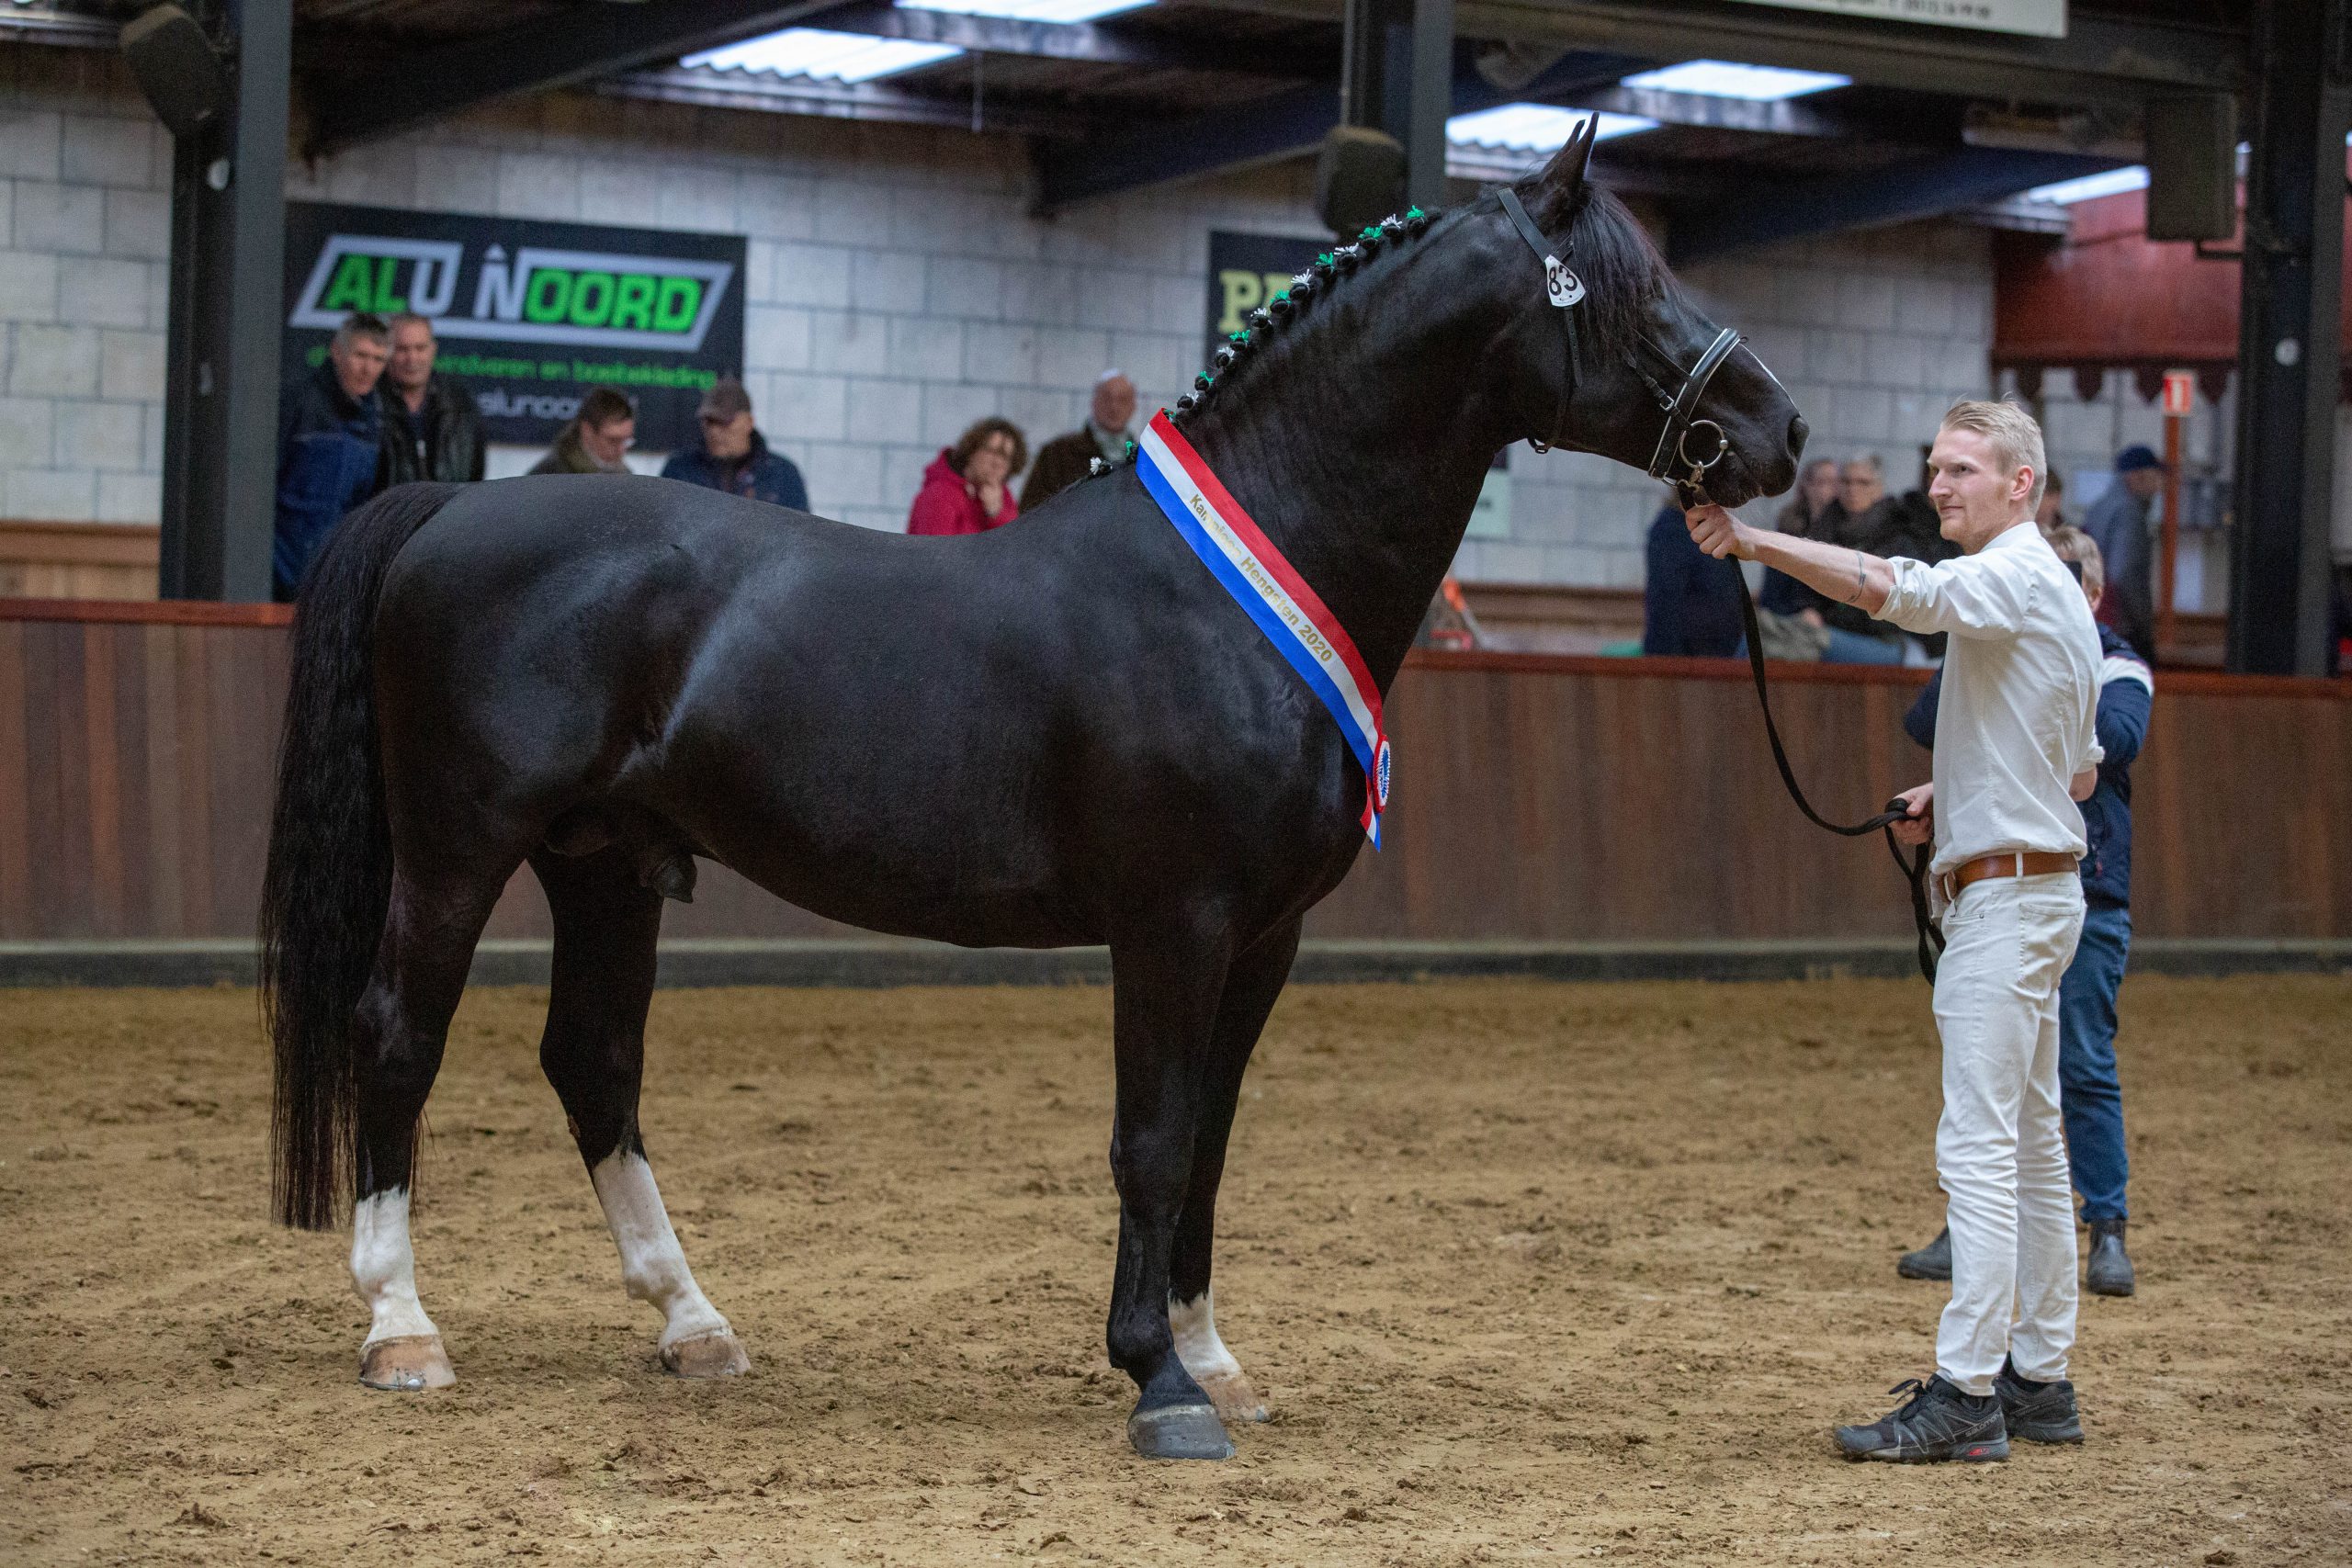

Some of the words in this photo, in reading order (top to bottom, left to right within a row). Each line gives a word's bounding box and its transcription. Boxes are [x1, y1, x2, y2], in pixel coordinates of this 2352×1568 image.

[324, 253, 462, 316] ALU
[472, 250, 702, 333] NOORD
[1548, 265, 1578, 297] 83
[1240, 556, 1301, 627] Hengsten
[1297, 623, 1333, 663] 2020
